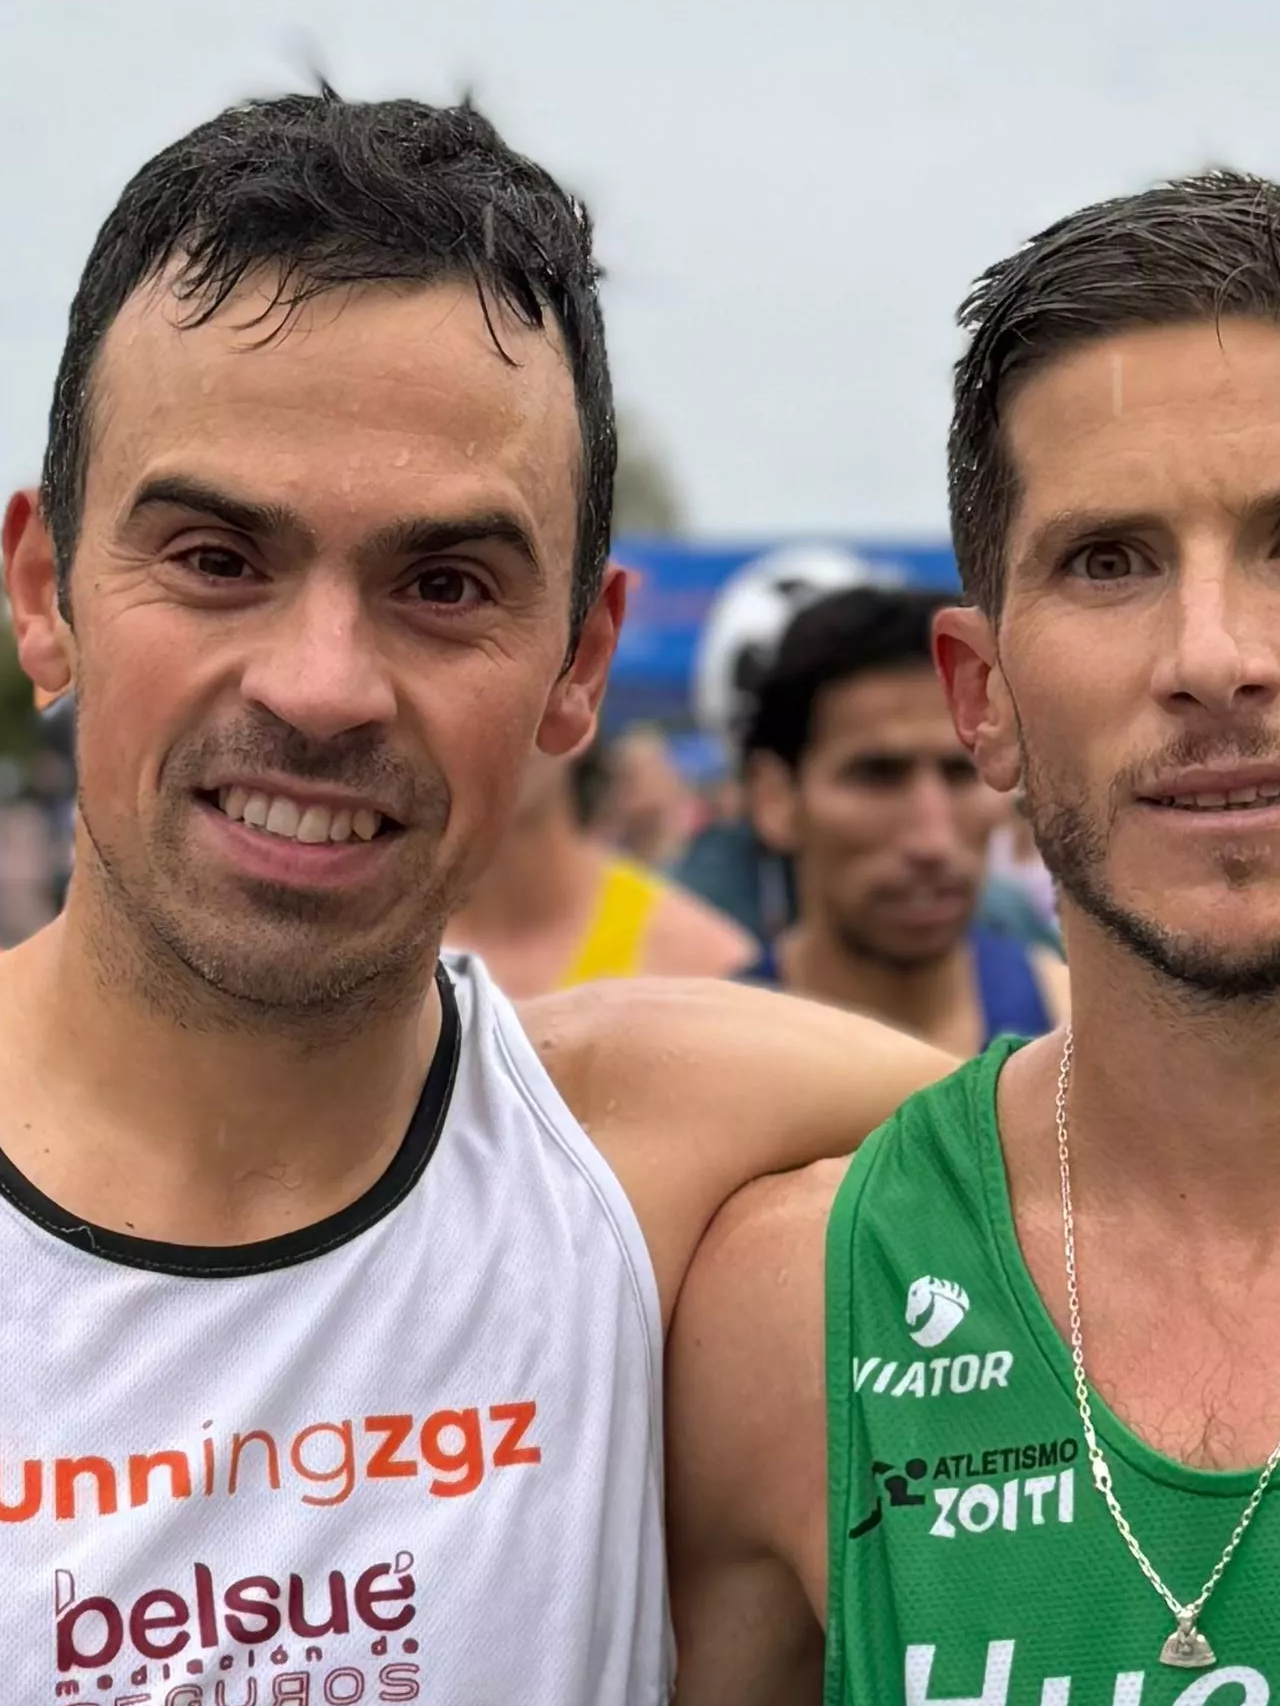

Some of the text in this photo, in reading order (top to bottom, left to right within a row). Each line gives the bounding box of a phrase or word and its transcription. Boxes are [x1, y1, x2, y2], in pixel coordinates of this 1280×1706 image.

[853, 1350, 1013, 1397] VIATOR
[932, 1438, 1078, 1481] ATLETISMO
[929, 1468, 1075, 1538] ZOITI
